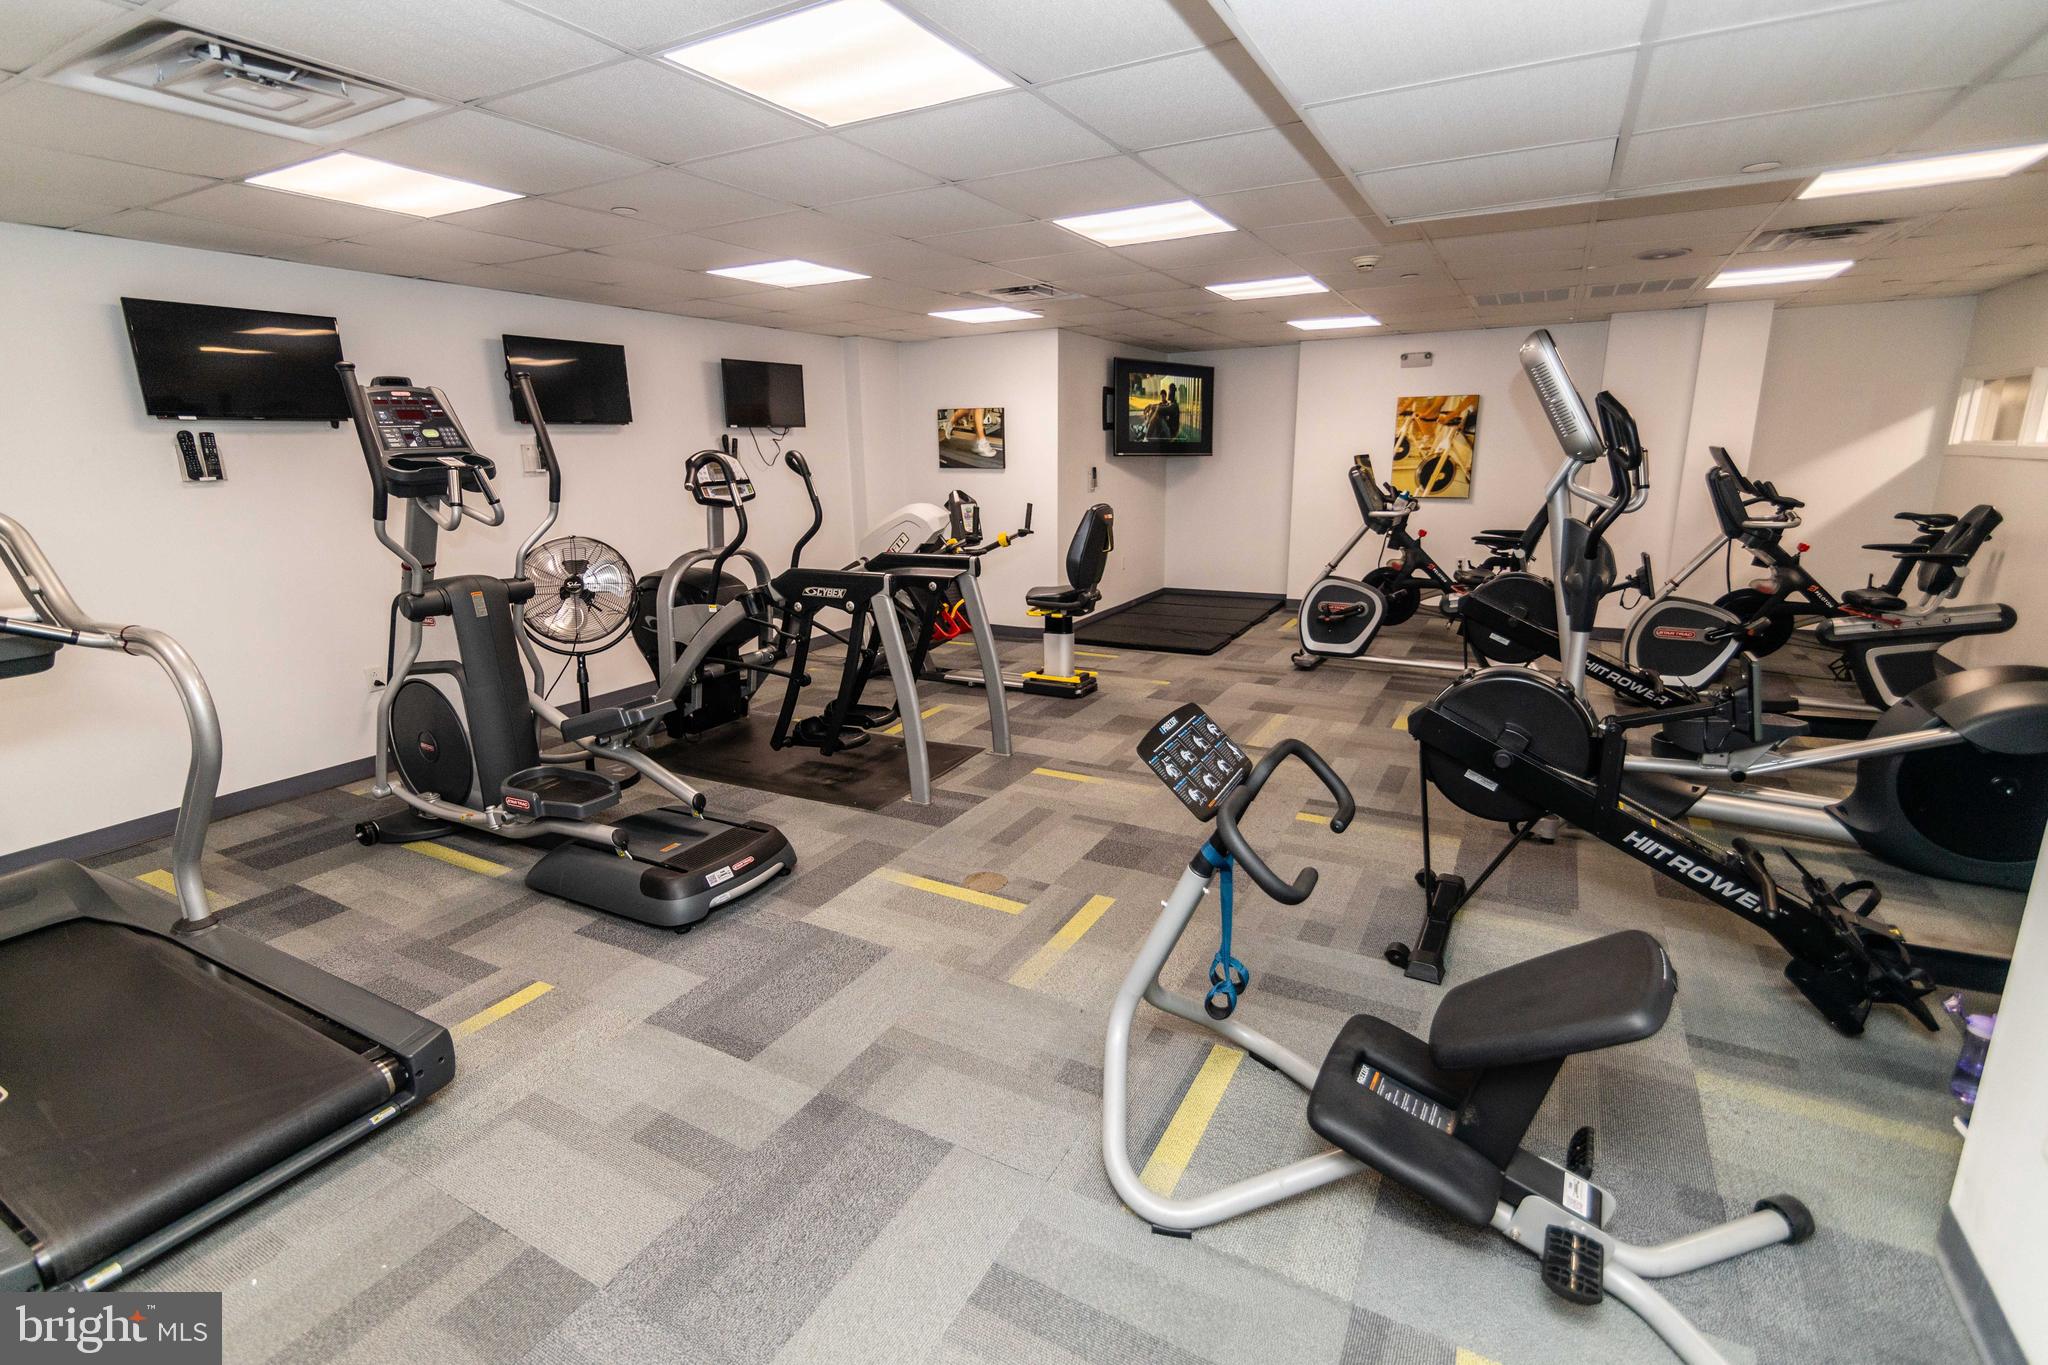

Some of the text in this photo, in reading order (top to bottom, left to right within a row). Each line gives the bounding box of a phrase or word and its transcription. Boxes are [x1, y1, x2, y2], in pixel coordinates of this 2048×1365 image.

[816, 588, 844, 598] CYBEX
[1815, 591, 1834, 608] PELOTON
[1622, 830, 1763, 912] HIIT ROWE
